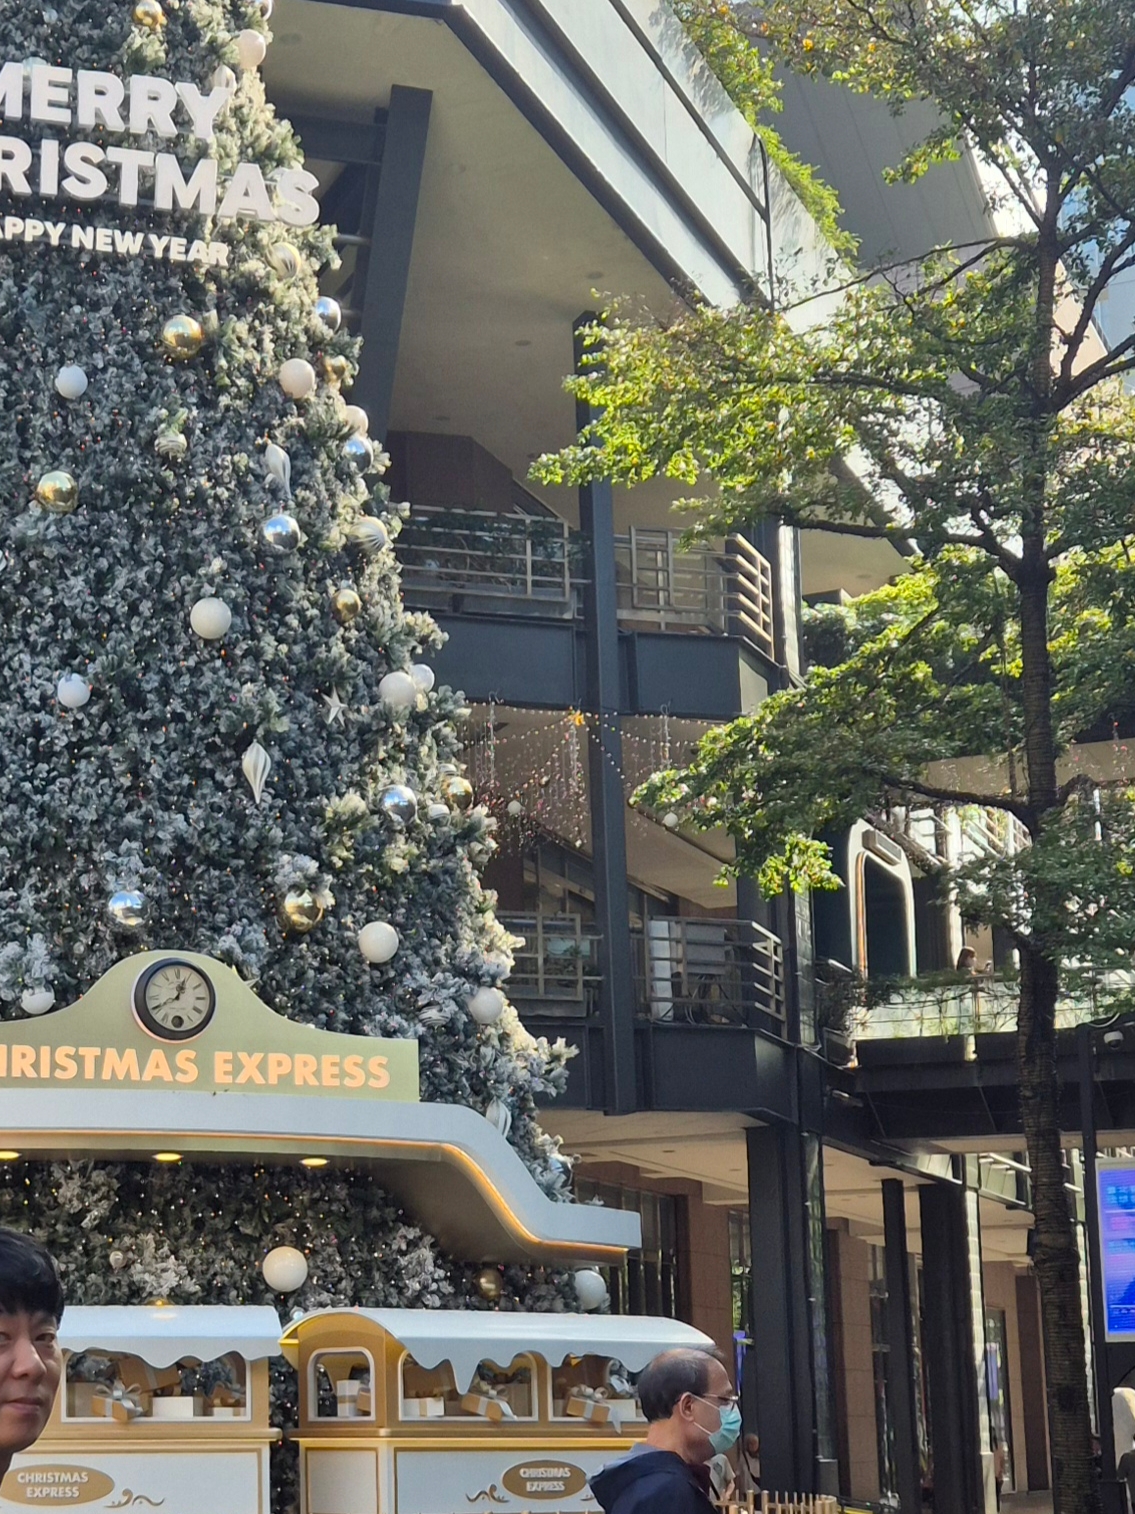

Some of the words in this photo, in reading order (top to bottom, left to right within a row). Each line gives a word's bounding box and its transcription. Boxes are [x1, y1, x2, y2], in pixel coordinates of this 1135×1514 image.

[70, 223, 148, 258] NEW
[148, 234, 230, 268] YEAR
[214, 1050, 391, 1089] EXPRESS
[16, 1471, 89, 1484] CHRISTMAS
[519, 1467, 571, 1478] CHRISTMAS
[25, 1486, 80, 1498] EXPRESS
[527, 1481, 565, 1492] EXPRESS
